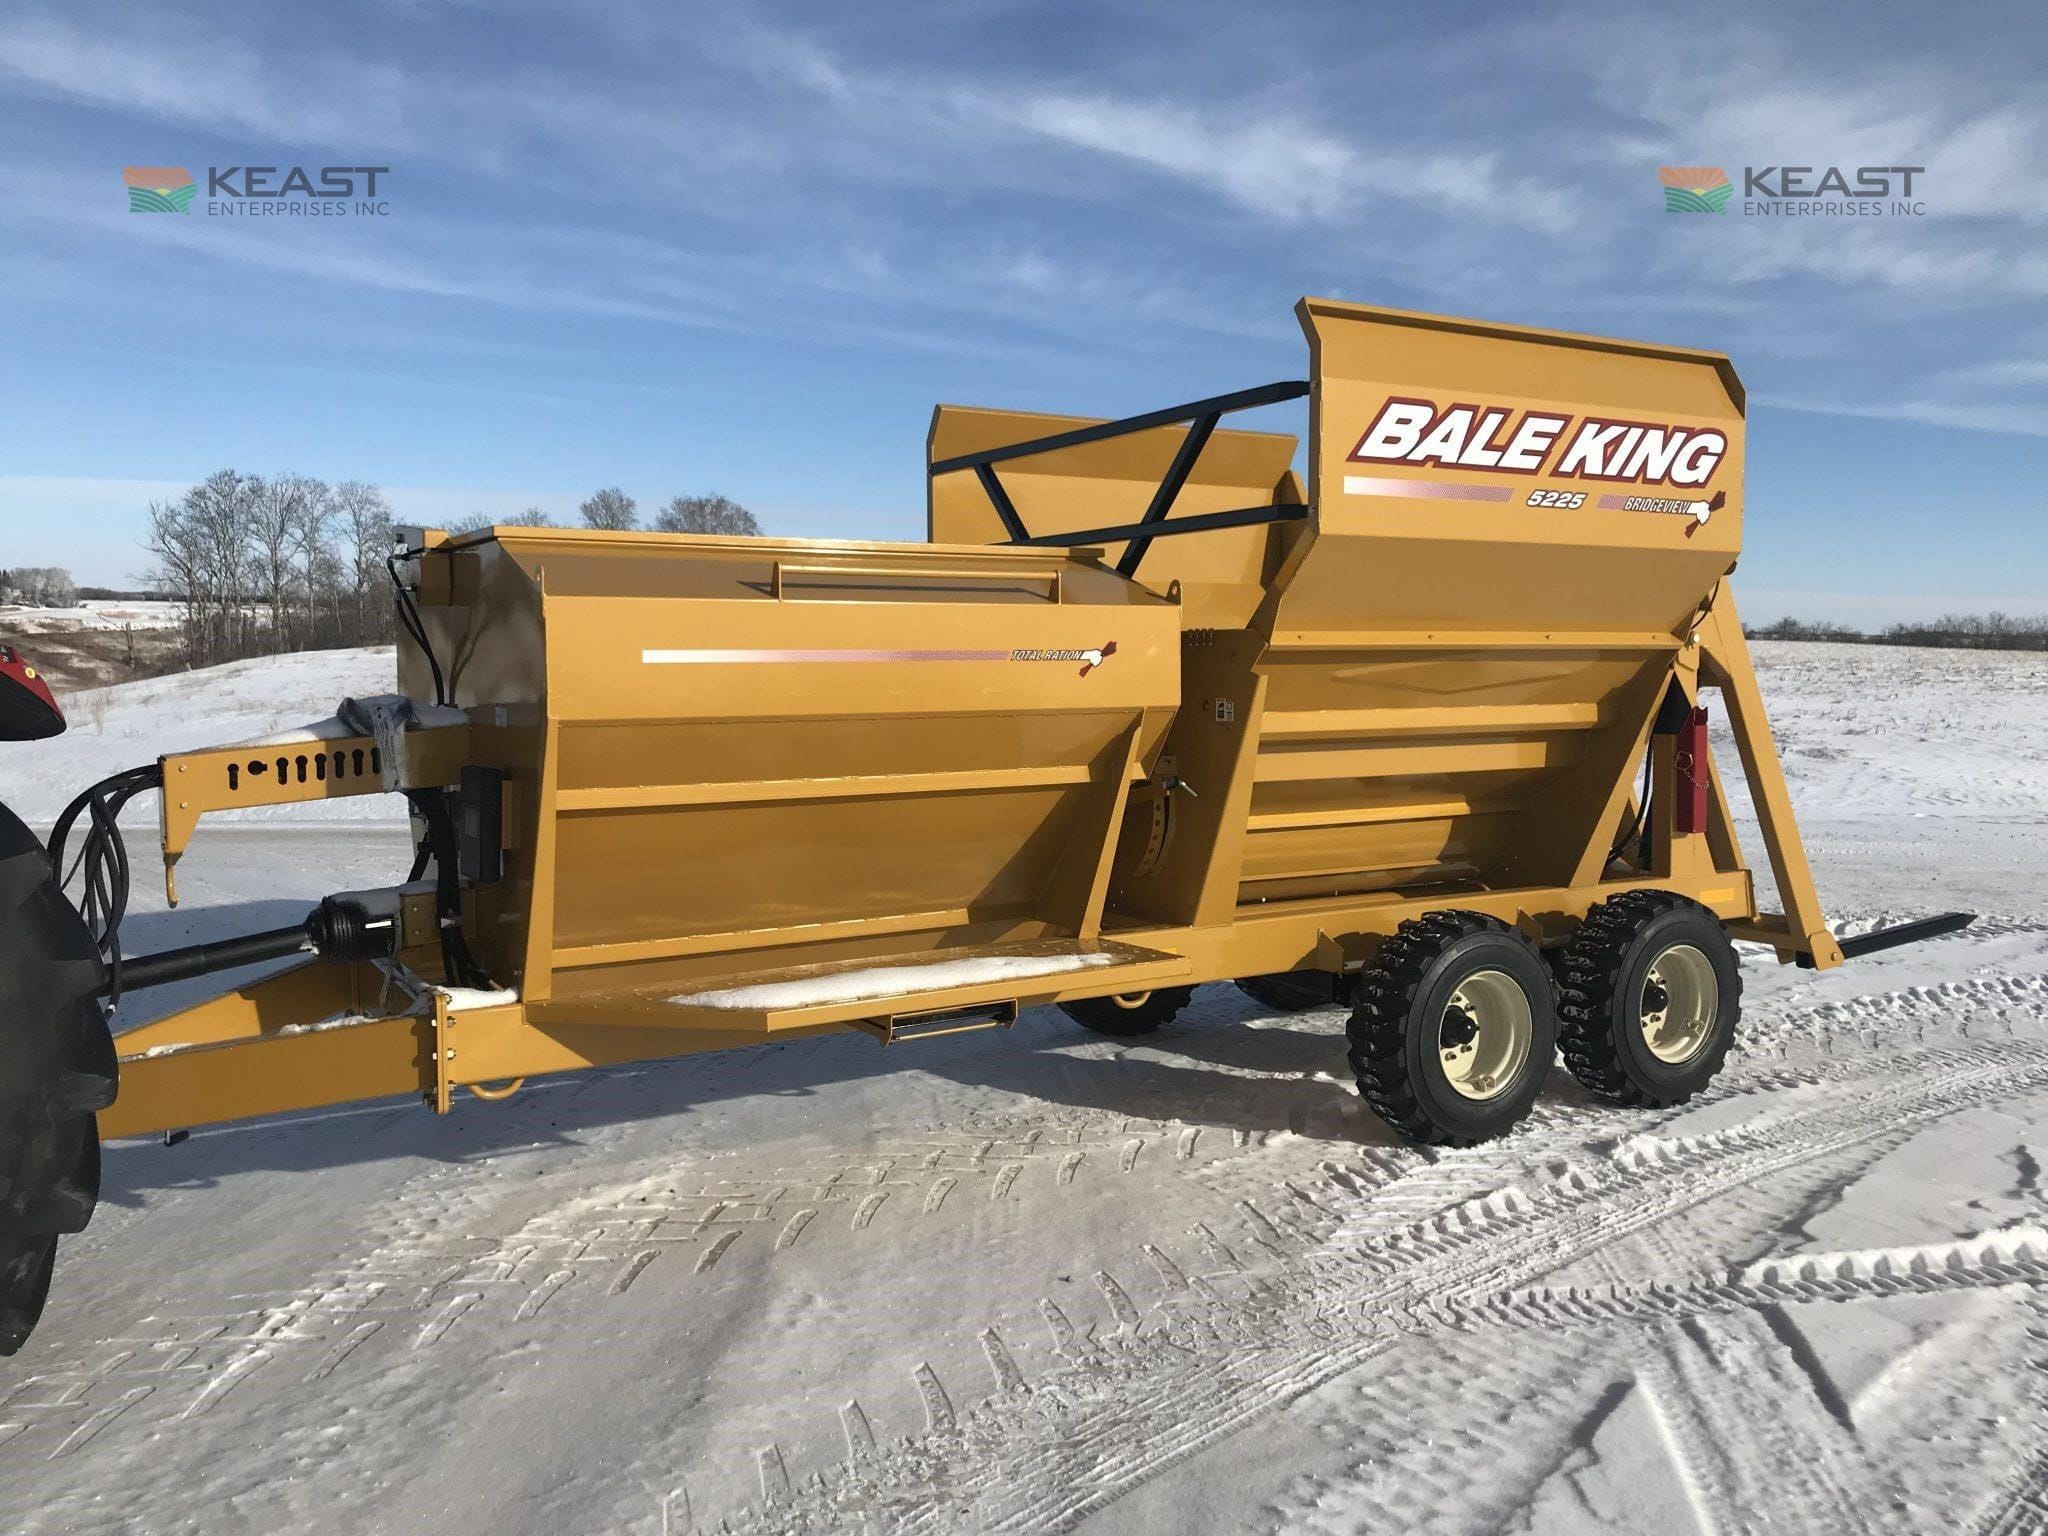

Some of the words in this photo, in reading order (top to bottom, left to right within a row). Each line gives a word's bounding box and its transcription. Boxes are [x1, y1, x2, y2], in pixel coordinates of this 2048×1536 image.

[1350, 398, 1572, 474] BALE
[1553, 419, 1727, 487] KING
[1527, 489, 1587, 509] 5225
[1624, 496, 1692, 514] BRIDGEVIEW
[1011, 650, 1043, 660] TOTAL
[1044, 650, 1083, 660] RATION
